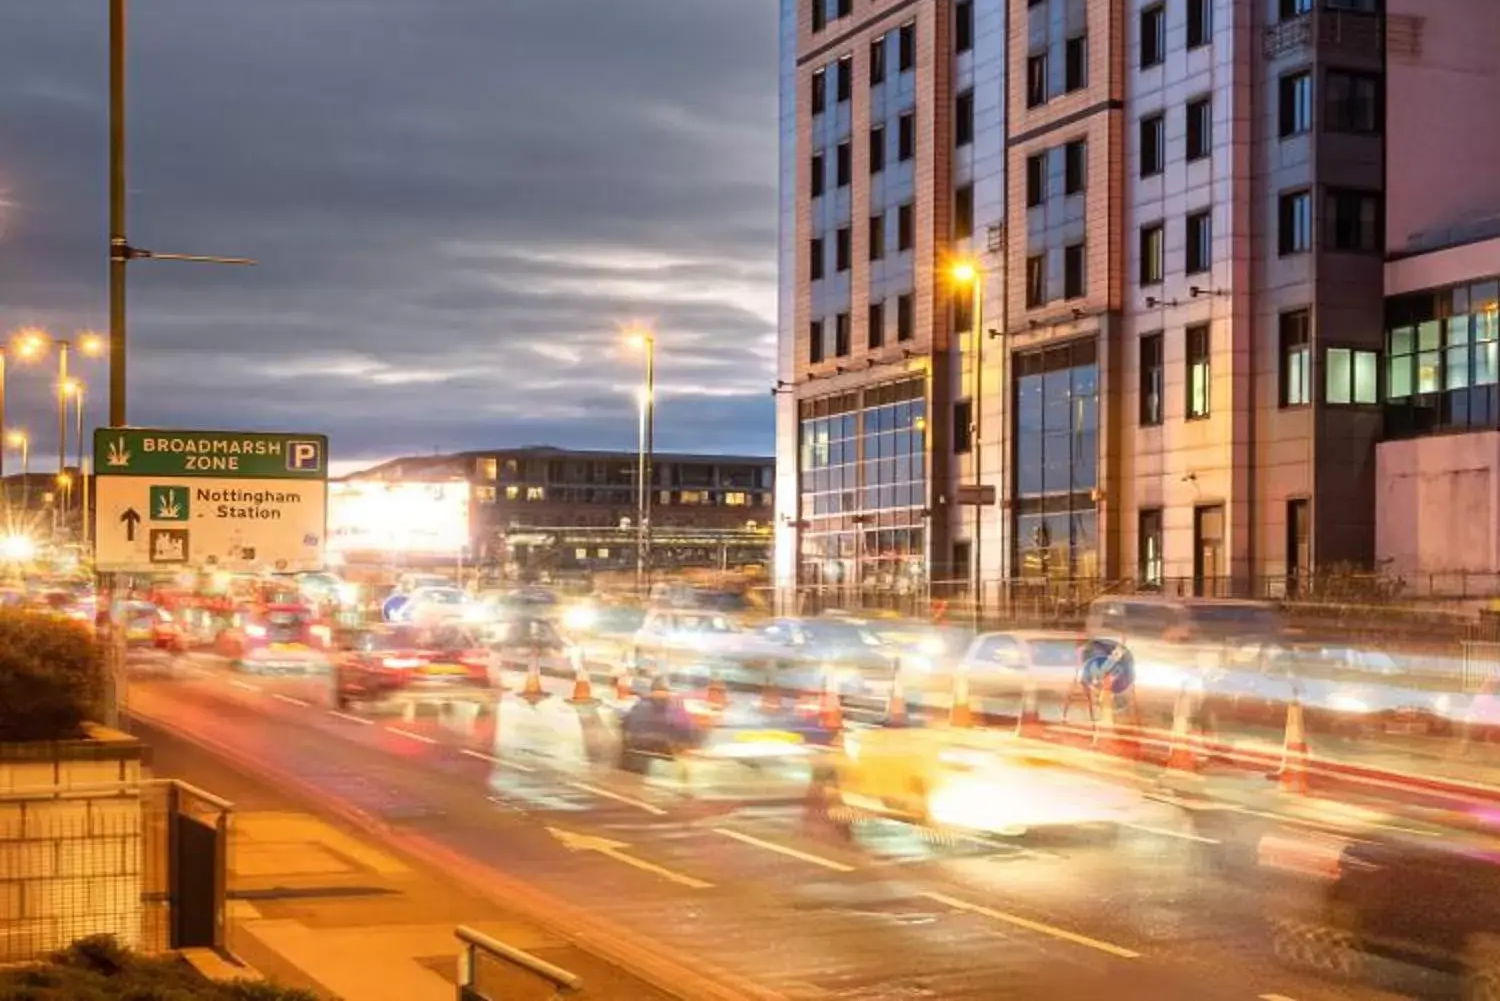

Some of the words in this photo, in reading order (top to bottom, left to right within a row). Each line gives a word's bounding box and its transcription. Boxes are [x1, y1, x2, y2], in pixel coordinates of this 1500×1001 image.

[143, 438, 281, 455] BROADMARSH
[185, 456, 239, 470] ZONE
[294, 445, 314, 467] P
[196, 488, 301, 504] Nottingham
[216, 504, 281, 519] Station
